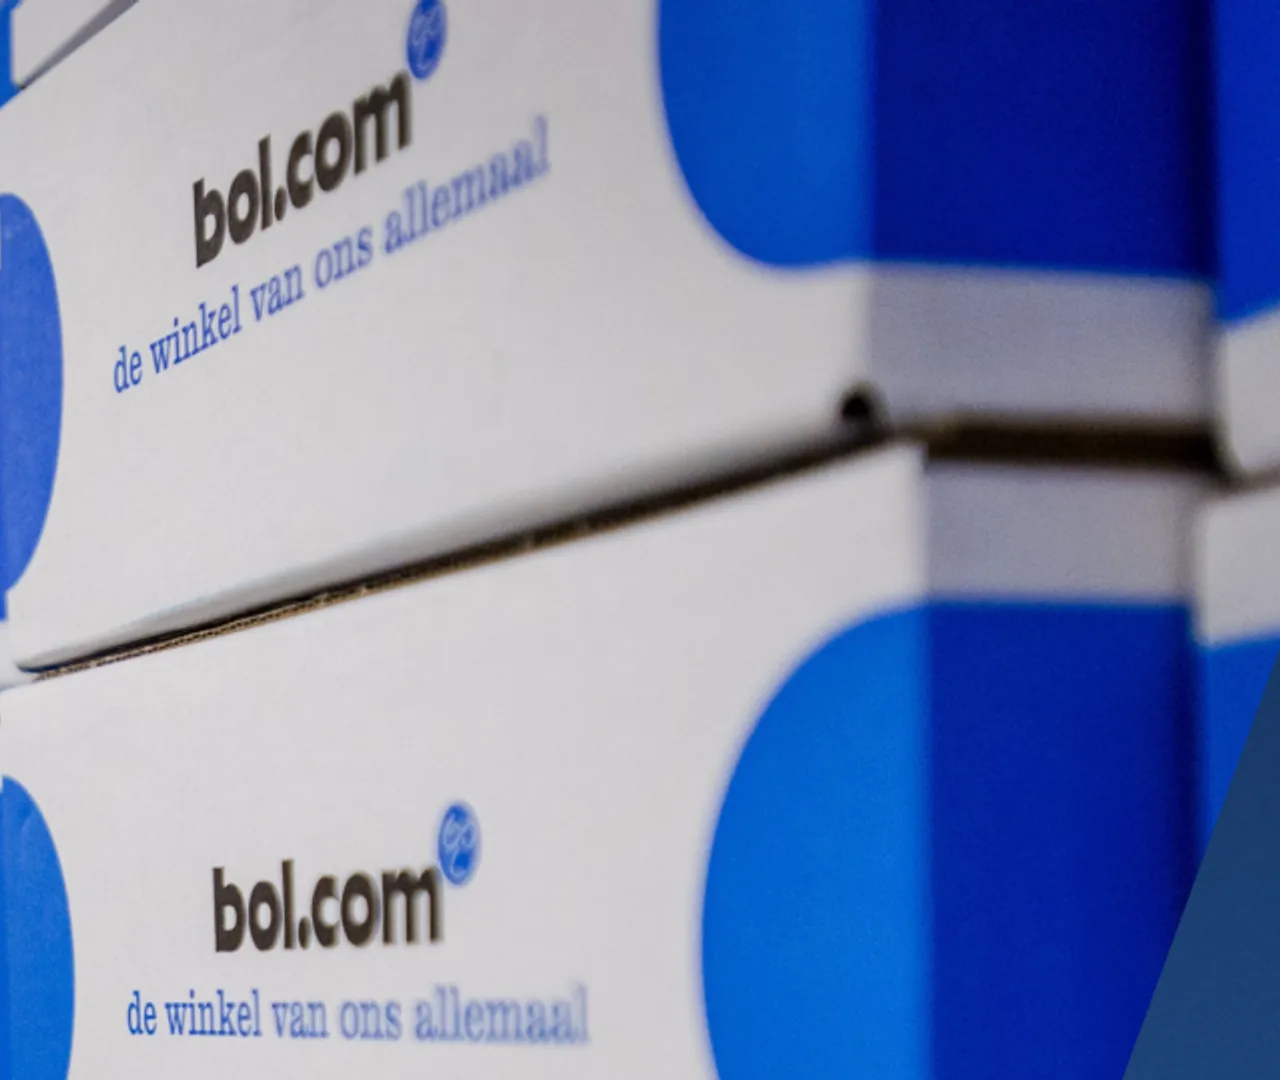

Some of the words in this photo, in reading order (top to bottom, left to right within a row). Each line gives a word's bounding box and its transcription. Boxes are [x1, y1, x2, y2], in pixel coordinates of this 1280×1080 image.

[192, 70, 413, 269] bol.com
[112, 344, 144, 395] de
[148, 283, 242, 375] winkel
[249, 265, 304, 322] van
[313, 228, 373, 289] ons
[382, 112, 550, 256] allemaal
[211, 858, 443, 954] bol.com
[125, 988, 158, 1037] de
[163, 987, 263, 1039] winkel
[270, 1001, 330, 1040] van
[338, 1001, 402, 1042] ons
[412, 982, 590, 1046] allemaal
